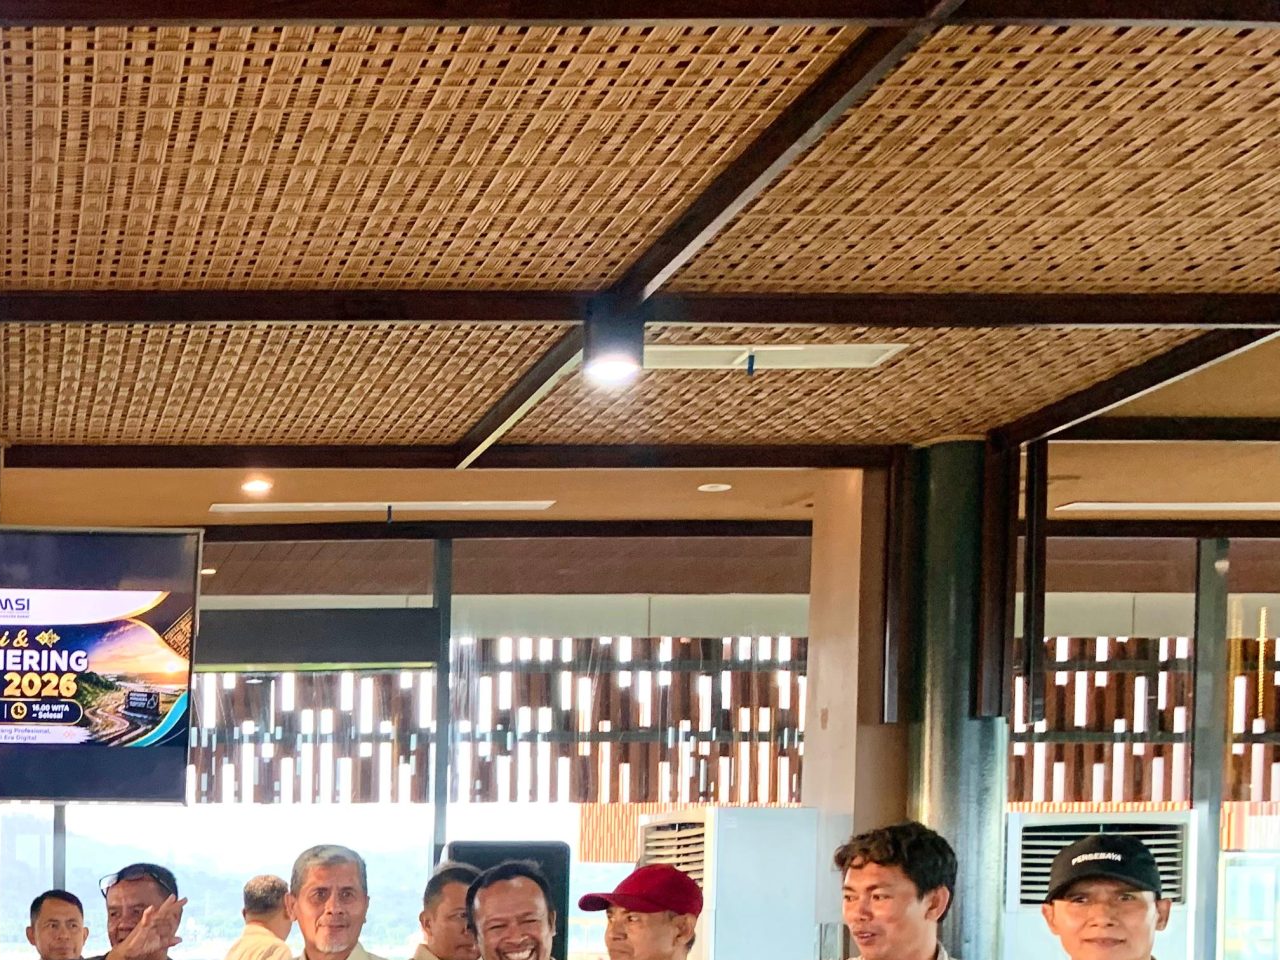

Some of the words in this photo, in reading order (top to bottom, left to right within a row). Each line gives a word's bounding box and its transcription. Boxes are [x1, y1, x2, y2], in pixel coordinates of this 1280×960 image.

[13, 629, 29, 647] &
[4, 672, 78, 697] 2026
[38, 711, 64, 719] Selesai
[1071, 852, 1122, 866] PERSEBAYA
